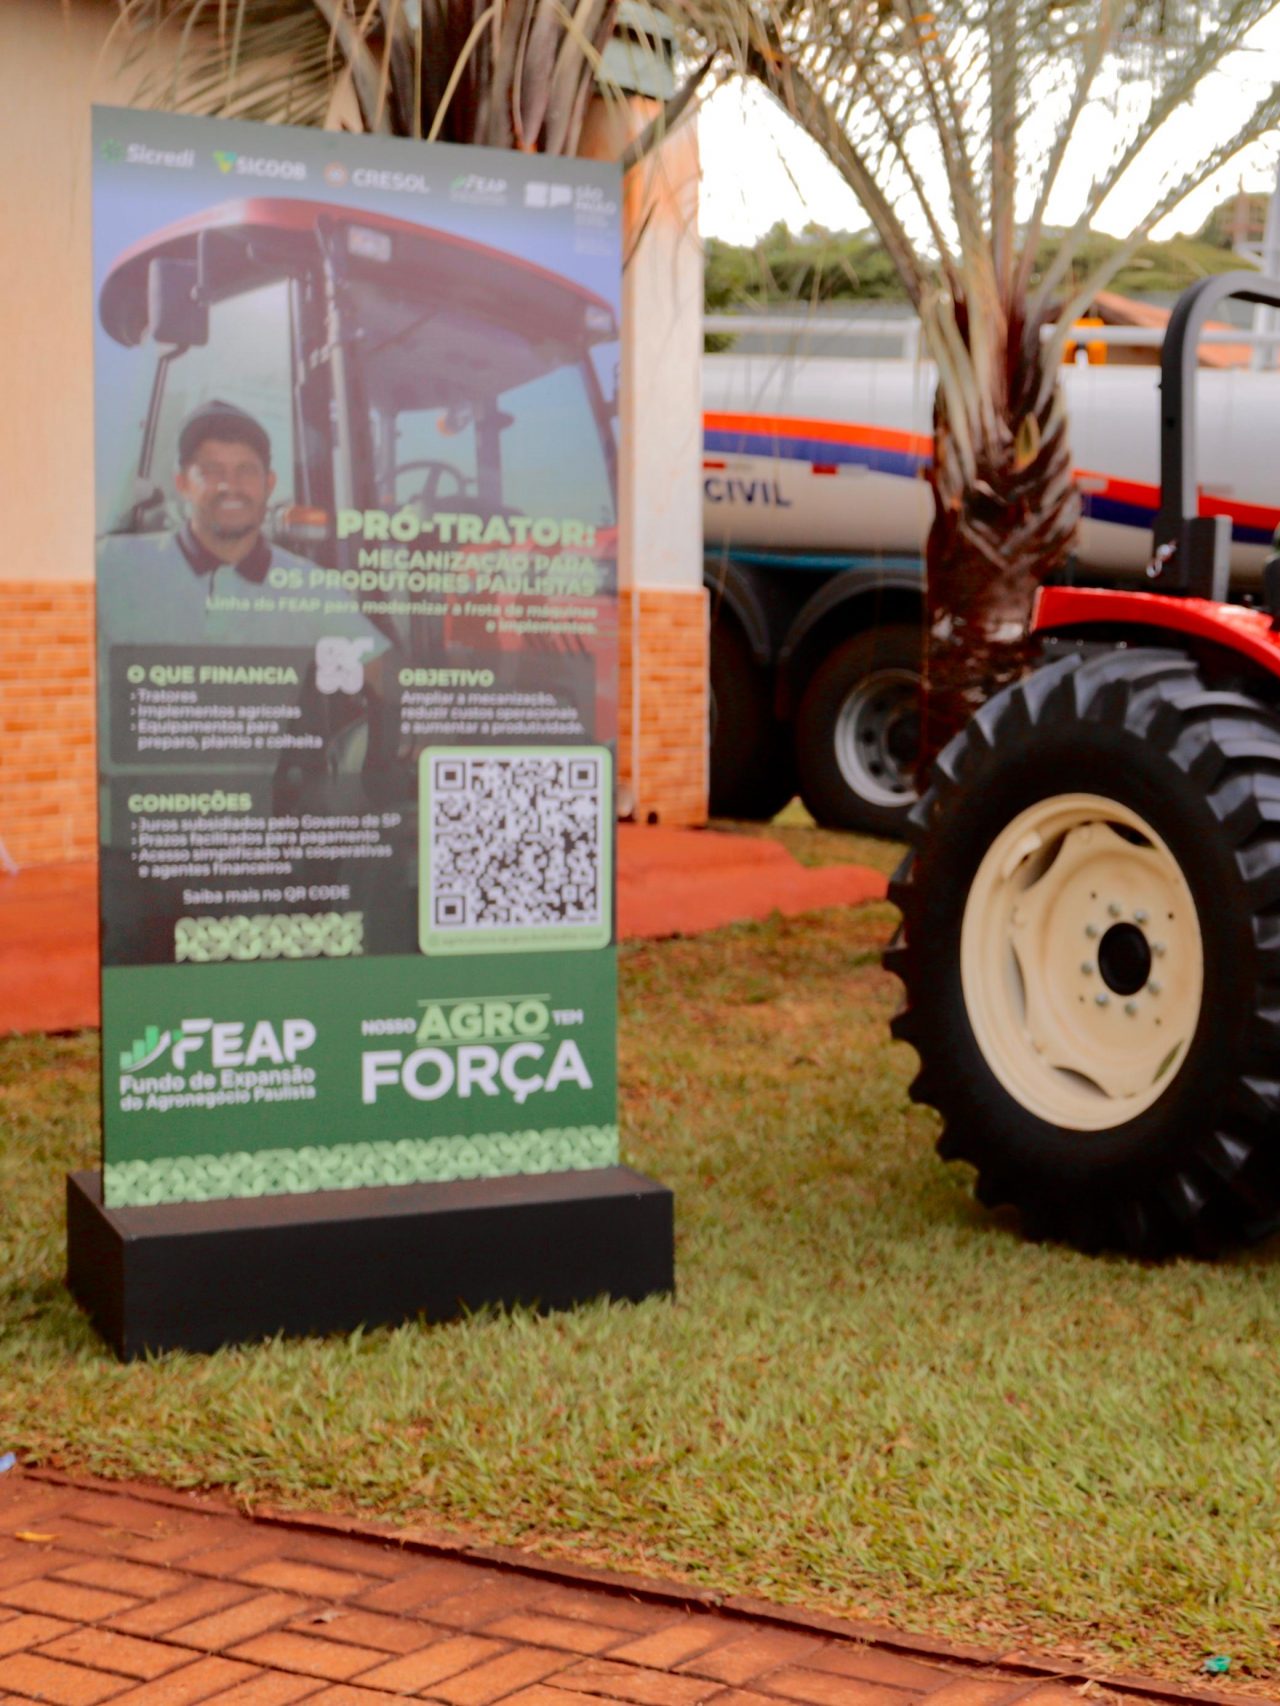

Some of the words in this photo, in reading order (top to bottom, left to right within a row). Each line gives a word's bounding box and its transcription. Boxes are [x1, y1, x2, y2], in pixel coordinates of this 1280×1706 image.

[236, 156, 307, 181] SICOOB
[352, 168, 430, 194] CRESOL
[704, 478, 792, 507] CIVIL
[336, 505, 597, 548] PRÓ-TRATOR:
[358, 548, 528, 575] MECANIZAÇÃO
[534, 553, 595, 575] PARA
[269, 567, 303, 589] OS
[309, 568, 470, 593] PRODUTORES
[476, 574, 596, 596] PAULISTAS
[324, 601, 360, 615] para
[363, 601, 448, 615] modernizar
[464, 603, 500, 617] frota
[506, 604, 524, 618] de
[127, 665, 145, 684] O
[150, 665, 195, 686] QUE
[199, 666, 299, 685] FINANCIA
[398, 668, 495, 687] OBJETIVO
[137, 687, 198, 703] Tratores
[401, 690, 454, 707] Ampliar
[138, 704, 235, 720] Implementos
[237, 704, 301, 720] agrícolas
[401, 706, 448, 720] reduzir
[451, 707, 494, 720] custos
[496, 706, 578, 721] operacionais
[138, 718, 244, 735] Equipamentos
[246, 720, 279, 735] para
[412, 721, 479, 735] aumentar
[201, 734, 252, 751] plantio
[254, 736, 264, 749] e
[266, 733, 323, 749] colheita
[128, 790, 252, 816] CONDIÇÕES
[139, 816, 178, 832] Juros
[181, 815, 265, 832] subsidiados
[268, 815, 299, 831] pelo
[301, 814, 359, 830] Governo
[361, 814, 380, 828] de
[382, 813, 401, 828] SP
[139, 832, 187, 847] Prazos
[190, 831, 263, 846] facilitados
[265, 832, 297, 847] para
[299, 830, 380, 846] pagamento
[139, 847, 190, 862] Acesso
[192, 846, 280, 863] simplificado
[283, 846, 303, 859] via
[305, 845, 392, 860] cooperativas
[139, 865, 149, 878] e
[151, 863, 211, 880] agentes
[212, 861, 292, 876] financeiros
[183, 889, 223, 904] Saiba
[225, 887, 260, 903] mais
[263, 888, 282, 902] no
[284, 885, 306, 903] QR
[308, 885, 350, 901] CODE
[361, 1017, 416, 1036] NOSSO
[416, 1000, 549, 1041] AGRO
[552, 1009, 584, 1026] TEM
[172, 1018, 317, 1070] FEAP
[120, 1073, 185, 1095] Fundo
[189, 1070, 216, 1090] de
[220, 1064, 316, 1090] Expansão
[361, 1039, 593, 1104] FORÇA
[120, 1095, 143, 1112] do
[146, 1088, 250, 1112] Agronegócio
[254, 1083, 316, 1102] Paulista
